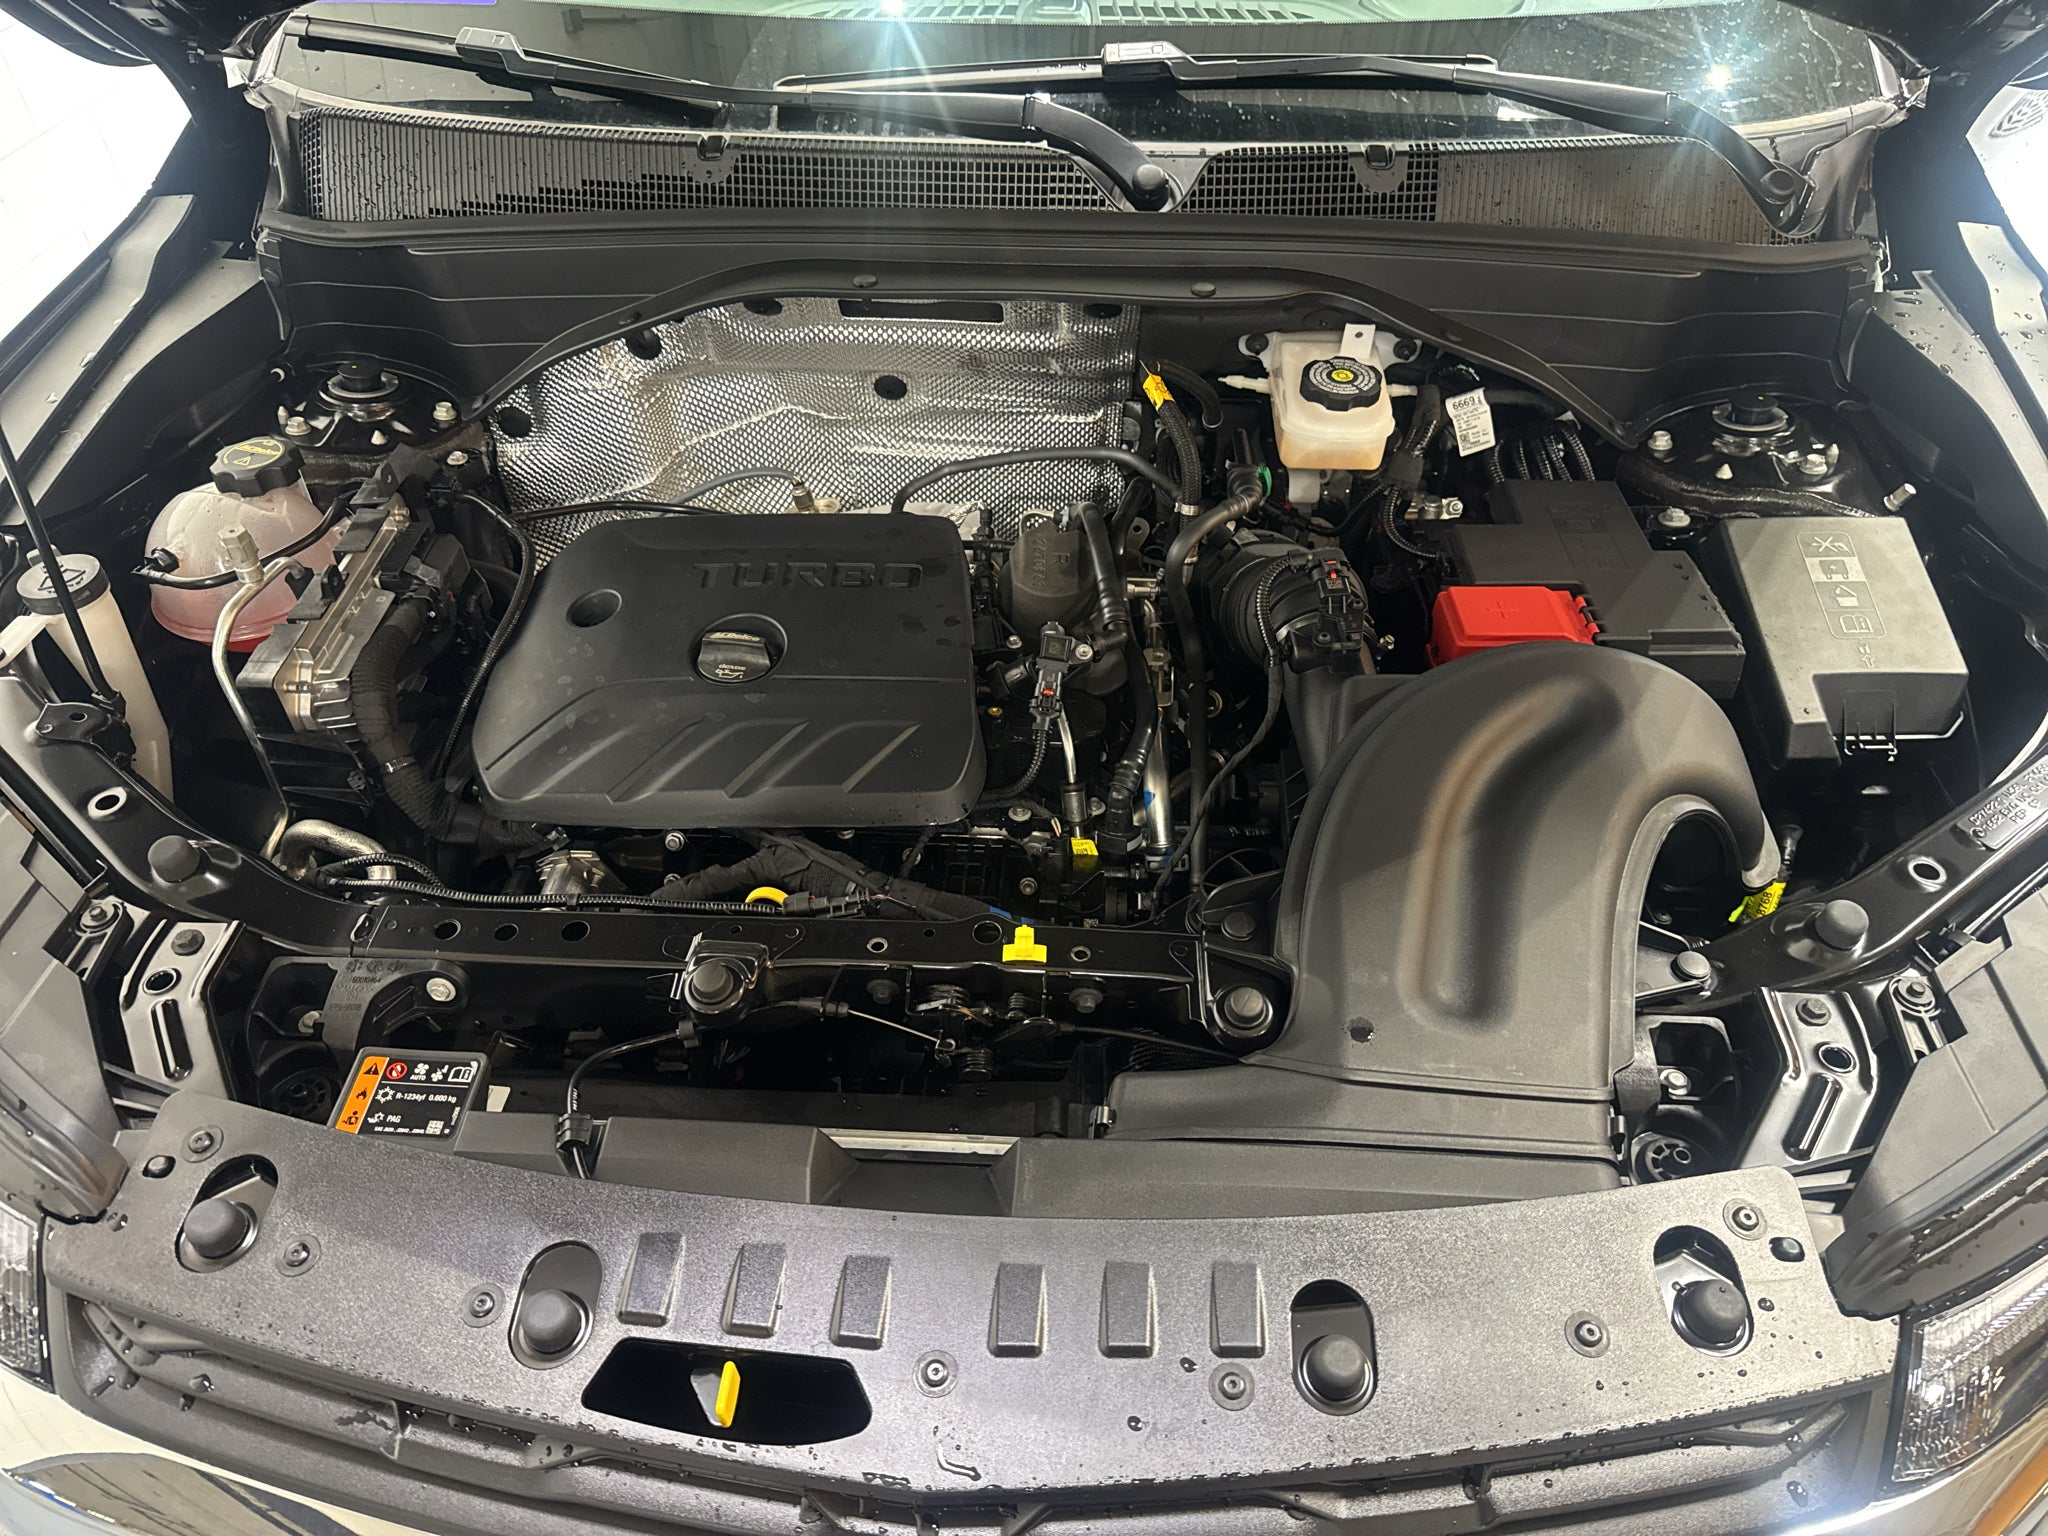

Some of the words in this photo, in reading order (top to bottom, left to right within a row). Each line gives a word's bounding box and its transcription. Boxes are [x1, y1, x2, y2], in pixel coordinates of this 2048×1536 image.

[1452, 396, 1475, 410] 6669
[692, 562, 923, 589] TURBO
[709, 631, 761, 643] ACDelco
[718, 663, 747, 672] dexos
[1756, 891, 1773, 916] 8768
[395, 1092, 427, 1103] R-1234yf
[448, 1095, 457, 1104] kg
[386, 1115, 402, 1123] PAG
